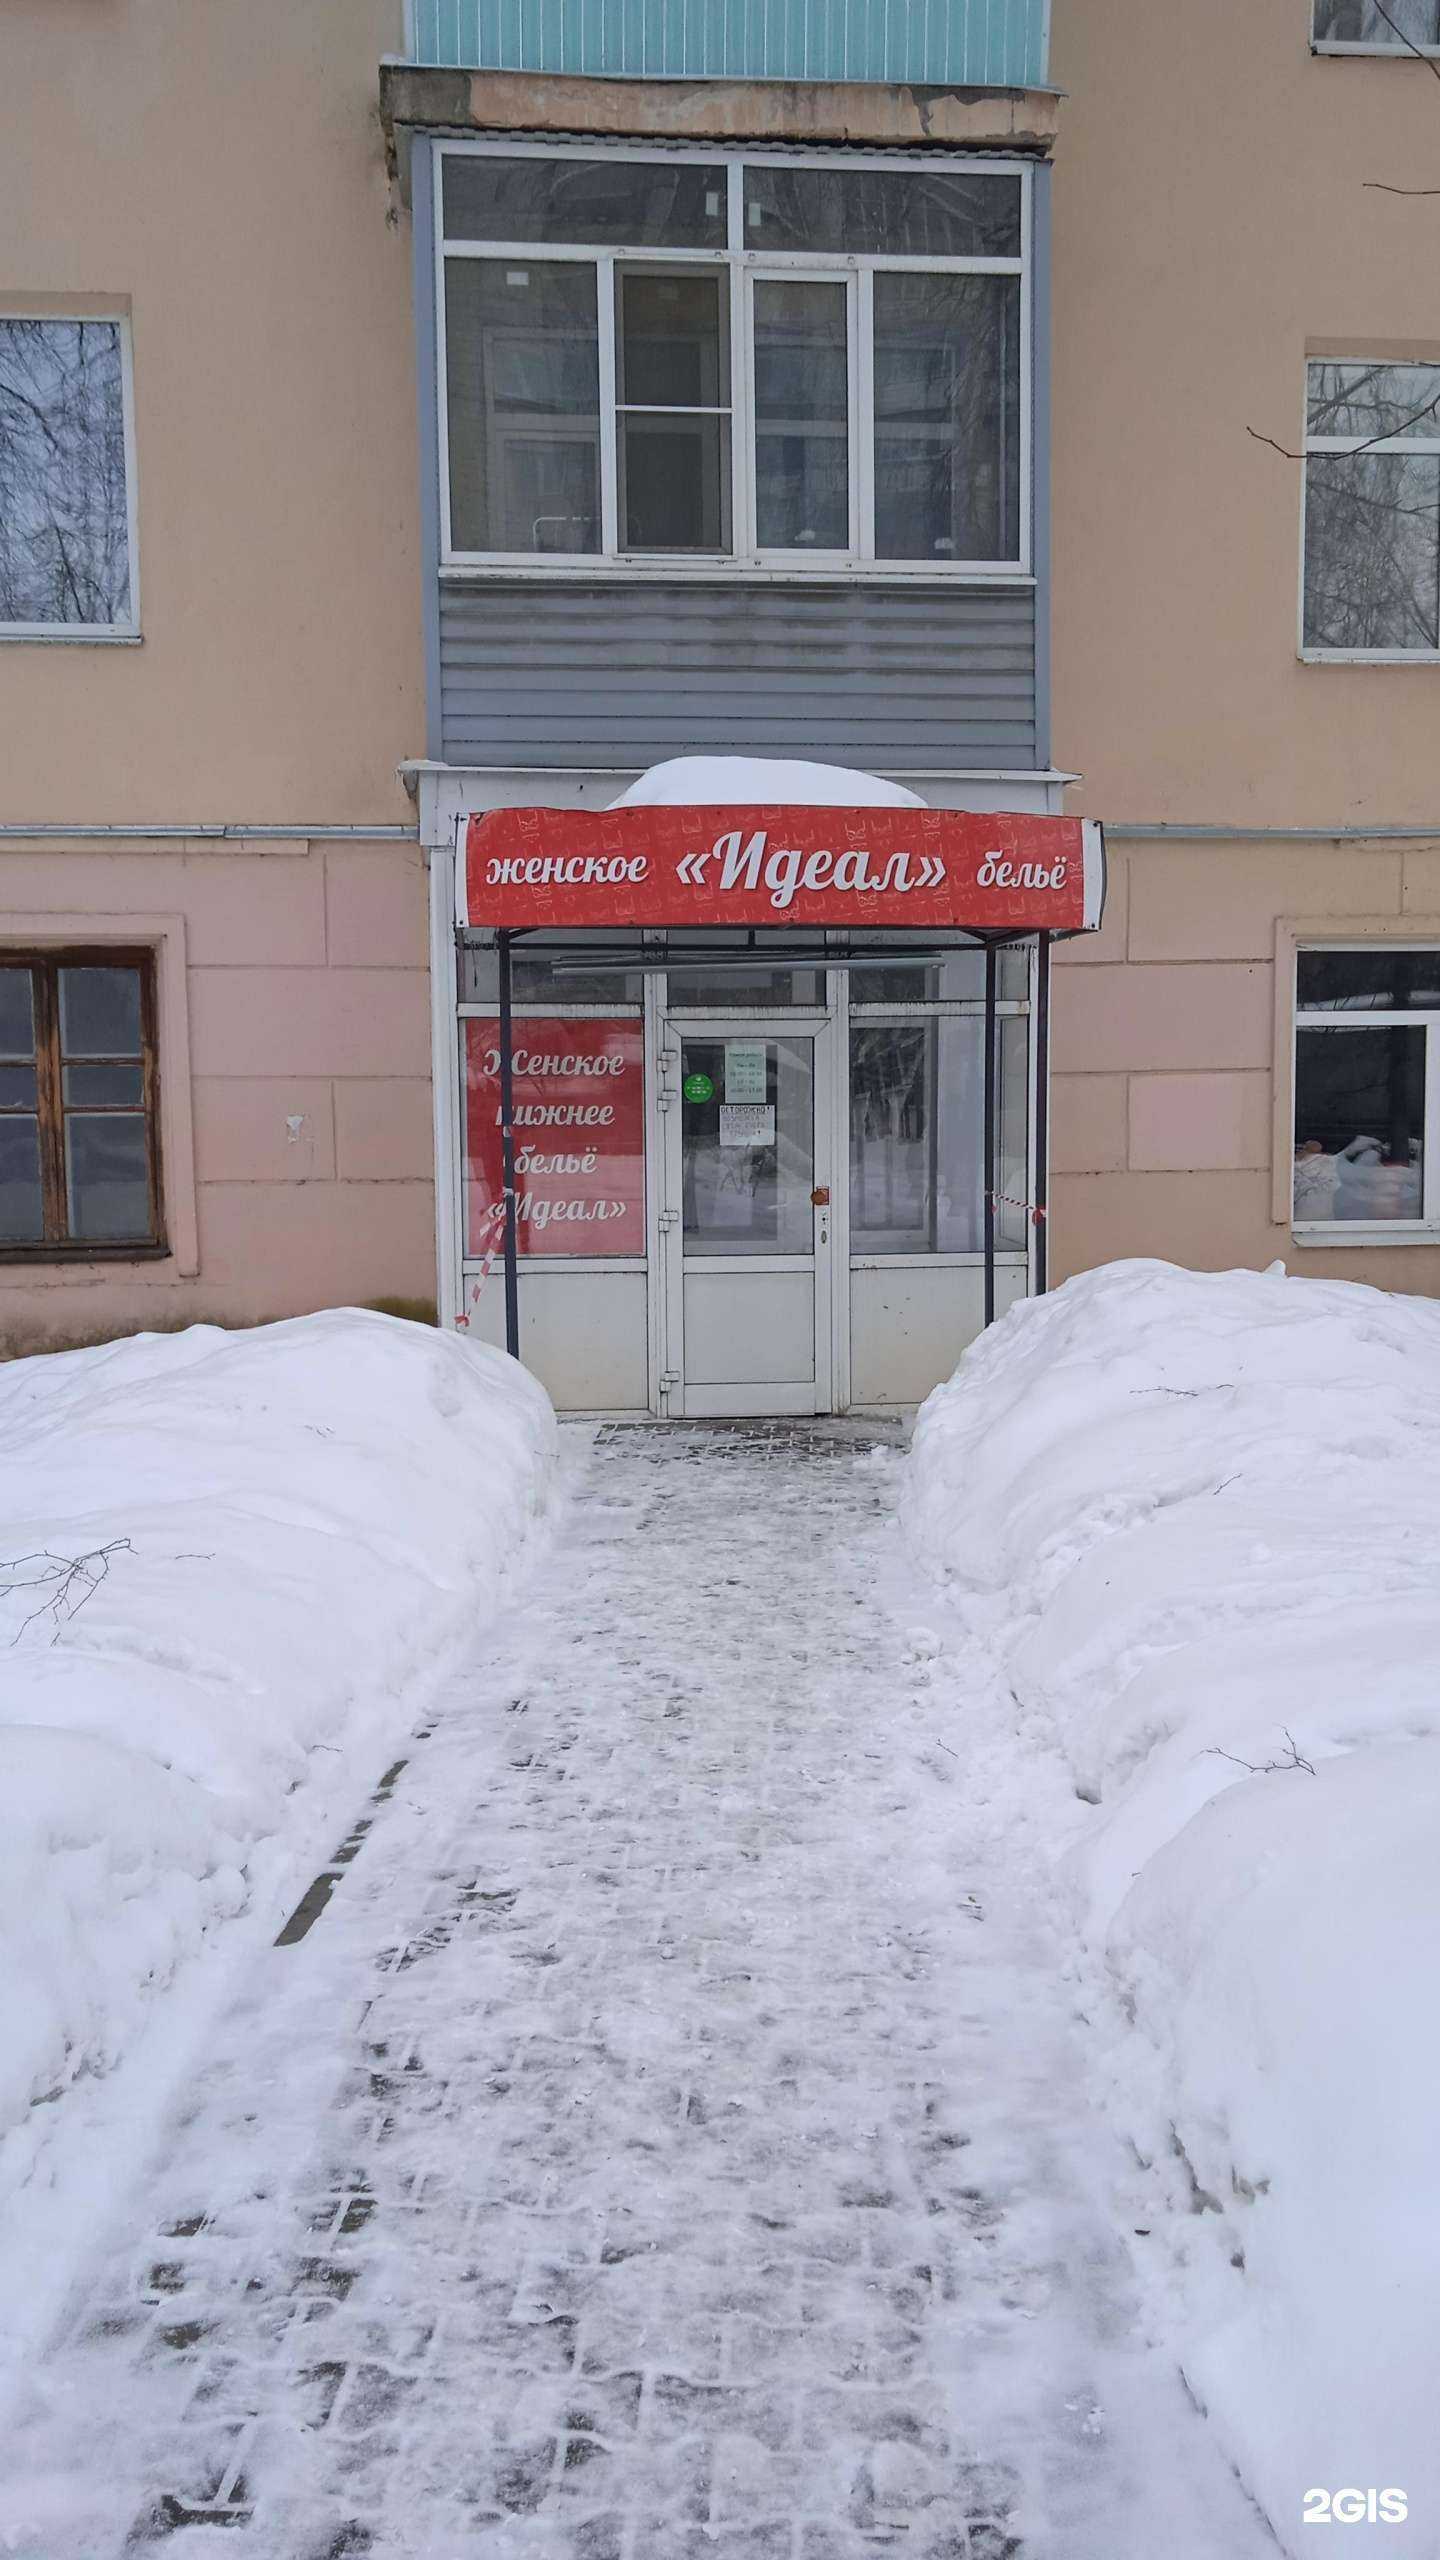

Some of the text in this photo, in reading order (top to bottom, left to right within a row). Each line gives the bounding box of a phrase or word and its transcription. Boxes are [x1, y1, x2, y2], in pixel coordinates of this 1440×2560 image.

[485, 831, 1068, 909] женское «Идеал» бельё
[513, 1144, 598, 1174] бельё
